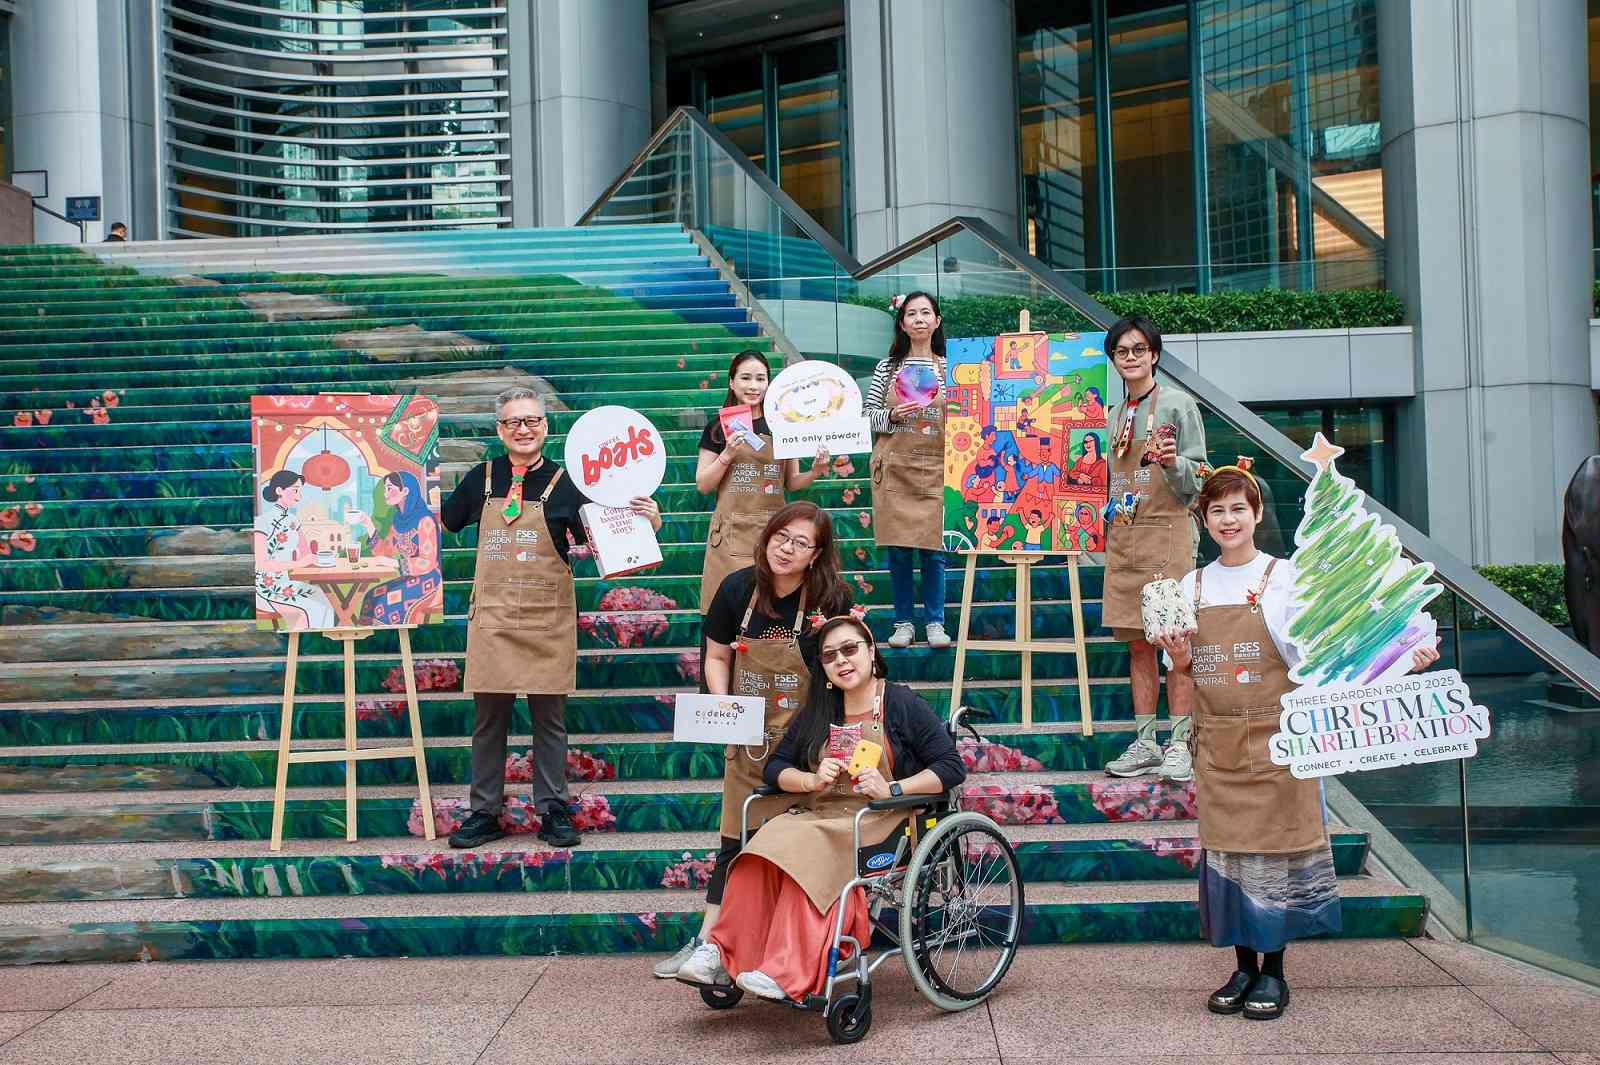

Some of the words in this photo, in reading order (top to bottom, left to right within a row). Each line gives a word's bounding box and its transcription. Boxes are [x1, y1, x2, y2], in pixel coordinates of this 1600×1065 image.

[782, 436, 799, 444] not
[802, 434, 822, 443] only
[581, 425, 655, 486] boats
[600, 511, 625, 523] based
[616, 518, 632, 527] true
[516, 529, 538, 538] FSES
[1193, 644, 1222, 655] THREE
[1233, 641, 1260, 653] FSES
[1192, 653, 1228, 665] GARDEN
[1192, 663, 1216, 673] ROAD
[774, 672, 799, 683] FSES
[1288, 694, 1328, 710] THREE
[1330, 687, 1383, 704] GARDEN
[1385, 681, 1421, 695] ROAD
[1424, 676, 1456, 689] 2025
[1287, 688, 1466, 736] CHRISTMAS
[1276, 713, 1483, 759] SHARELEBRATION
[1297, 759, 1342, 773] CONNECT
[1359, 752, 1397, 765] CREATE
[1414, 743, 1470, 757] CELEBRATE
